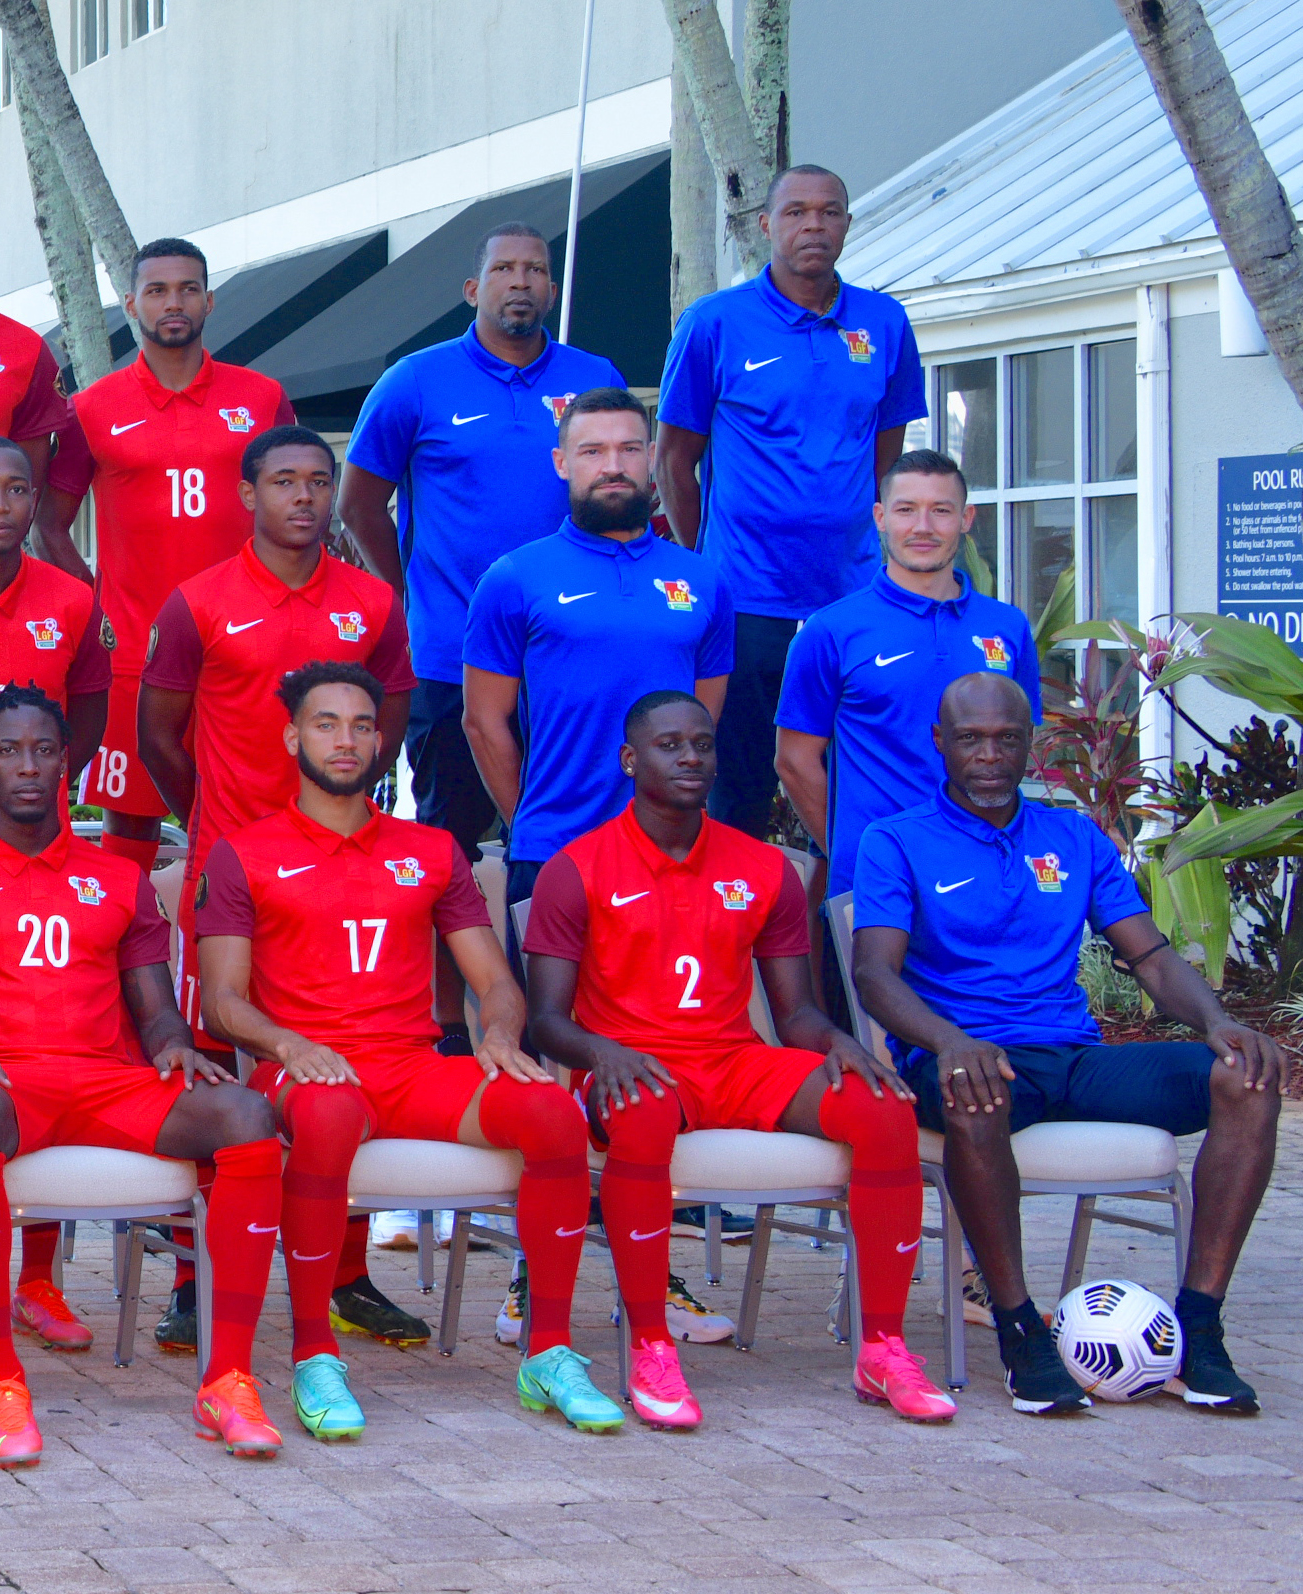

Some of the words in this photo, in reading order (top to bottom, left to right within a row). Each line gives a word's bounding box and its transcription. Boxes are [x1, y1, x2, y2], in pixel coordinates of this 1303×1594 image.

[850, 342, 867, 353] LGF
[232, 416, 245, 424] LGF
[1253, 469, 1287, 491] POOL
[165, 468, 206, 518] 18
[1233, 503, 1240, 511] No
[1241, 501, 1253, 511] food
[1261, 501, 1286, 511] beverages
[1287, 500, 1292, 508] in
[1233, 517, 1240, 525] No
[1241, 516, 1253, 526] glass
[1262, 515, 1281, 524] animals
[1282, 514, 1287, 523] in
[1288, 514, 1297, 523] the
[1241, 525, 1248, 534] 50
[1249, 525, 1259, 534] feet
[1260, 525, 1272, 533] from
[1273, 523, 1297, 534] unfenced
[1233, 540, 1251, 550] Bathing
[1273, 540, 1295, 549] persons.
[1233, 554, 1244, 562] Pool
[1285, 553, 1291, 561] 10
[1233, 568, 1251, 576] Shower
[1252, 567, 1269, 576] before
[1270, 566, 1292, 578] entering.
[1233, 582, 1240, 590] Do
[1241, 582, 1250, 590] not
[1251, 581, 1271, 590] swallow
[1272, 581, 1281, 589] the
[1282, 581, 1293, 592] pool
[669, 591, 688, 602] LGF
[341, 623, 356, 632] LGF
[37, 630, 52, 640] LGF
[987, 649, 1003, 660] LGF
[97, 745, 128, 798] 18
[398, 869, 414, 878] LGF
[1038, 868, 1055, 882] LGF
[81, 887, 95, 896] LGF
[726, 892, 742, 901] LGF
[17, 913, 70, 968] 20
[342, 918, 387, 973] 17
[675, 955, 701, 1009] 2
